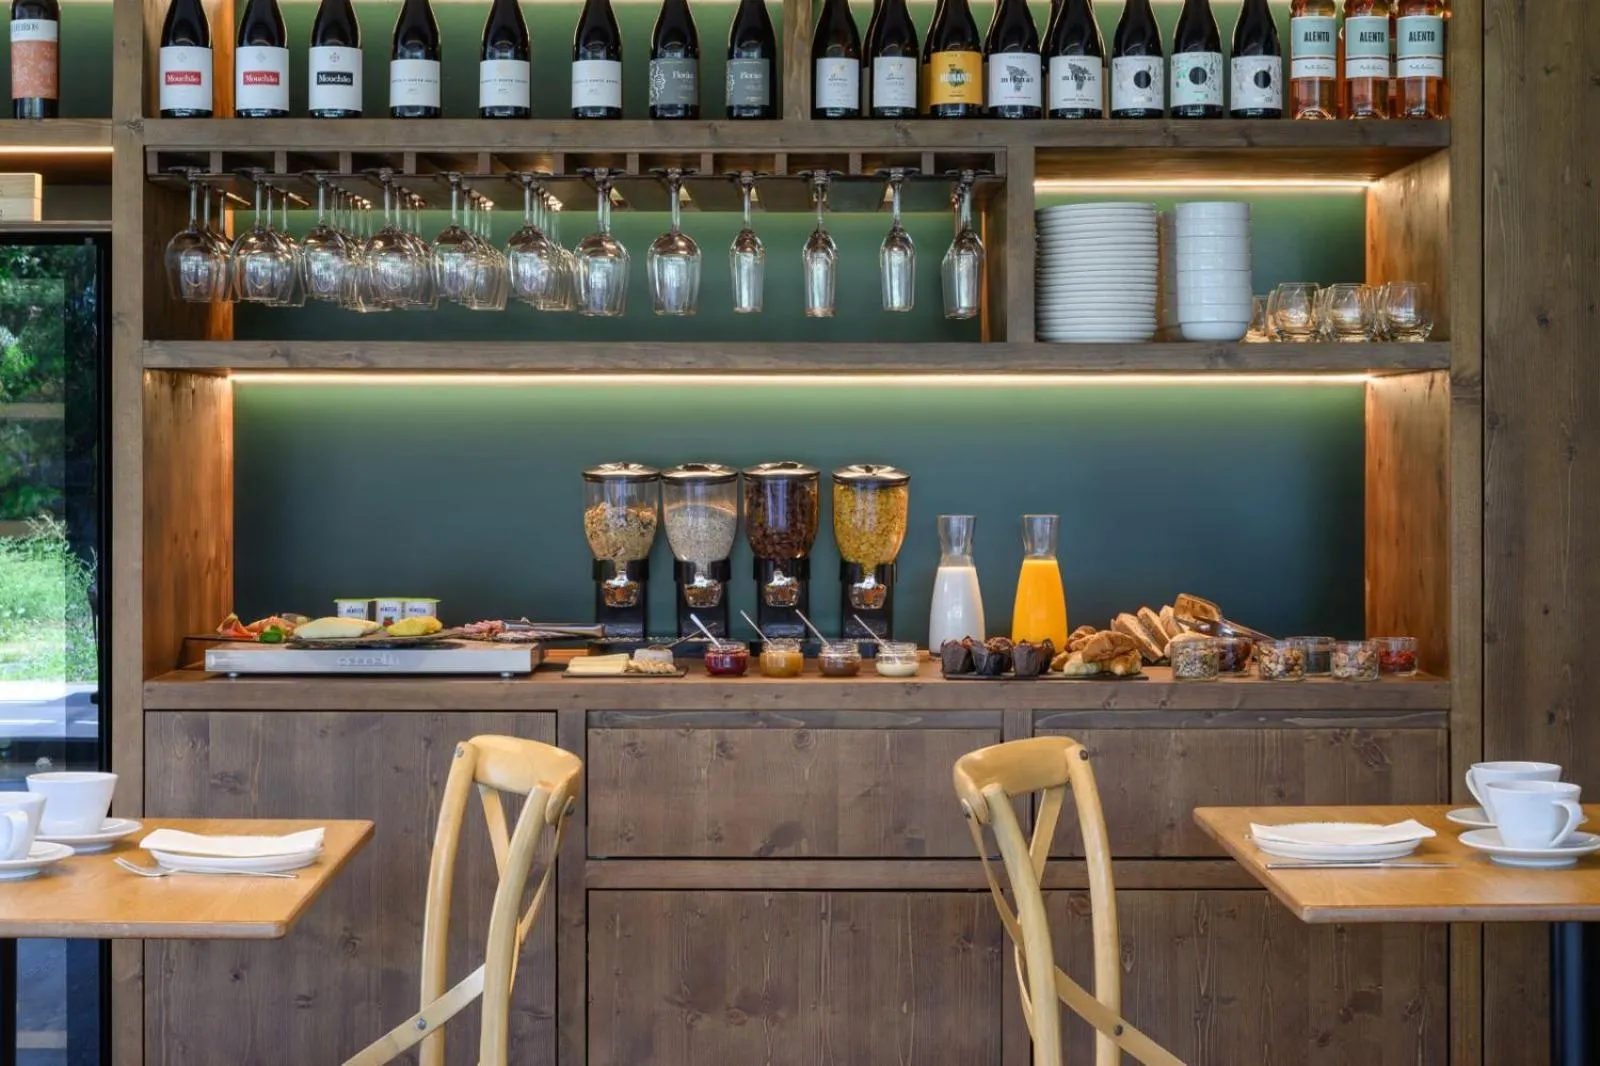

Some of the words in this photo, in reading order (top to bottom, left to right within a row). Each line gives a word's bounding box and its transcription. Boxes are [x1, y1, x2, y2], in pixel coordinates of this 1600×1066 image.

[1304, 31, 1330, 42] ALENTO
[1359, 31, 1385, 43] ALENTO
[1408, 30, 1435, 42] ALENTO
